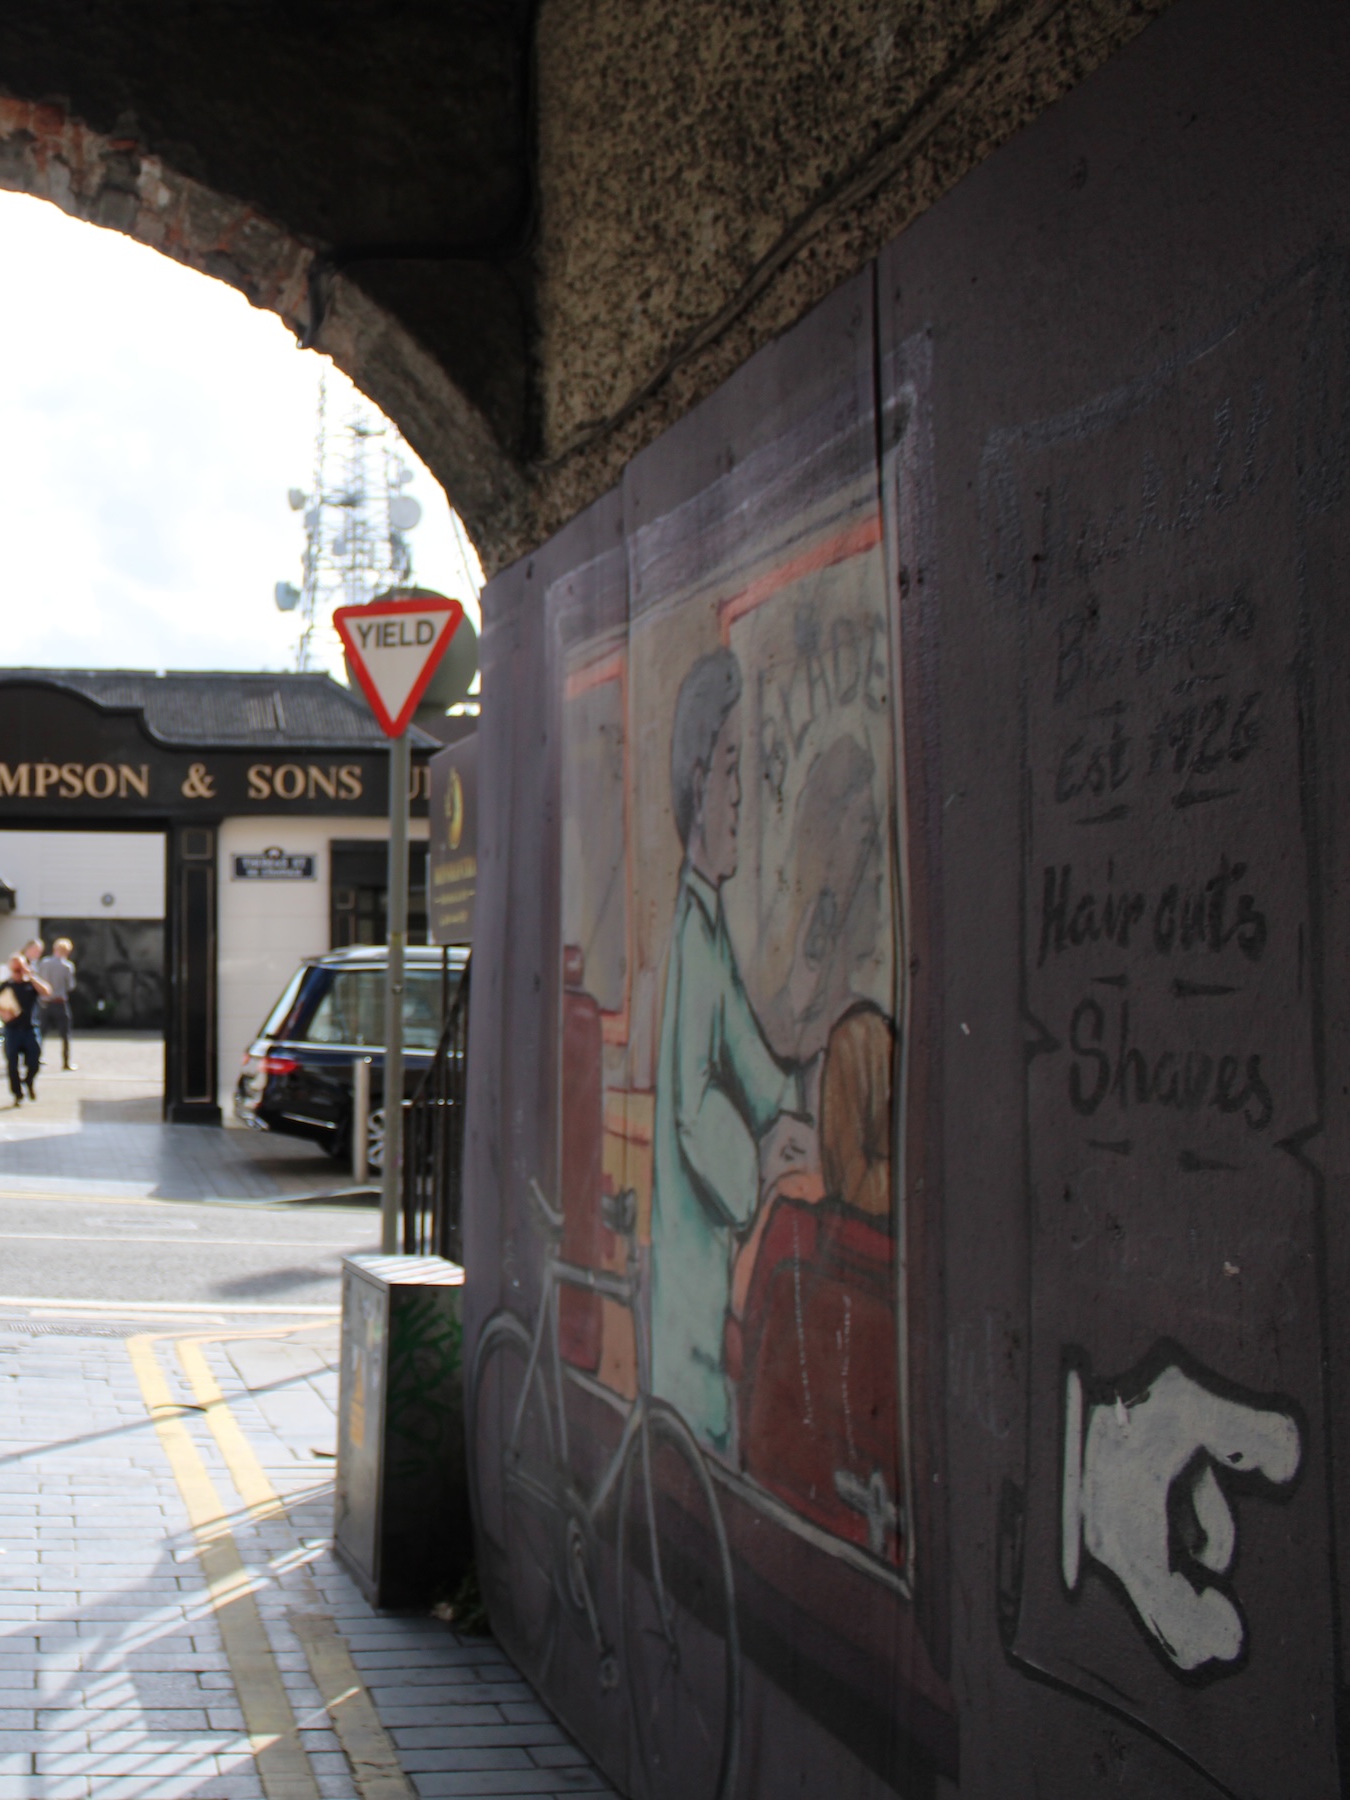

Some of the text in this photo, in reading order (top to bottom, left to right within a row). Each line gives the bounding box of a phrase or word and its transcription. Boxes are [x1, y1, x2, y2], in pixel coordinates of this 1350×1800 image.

[356, 619, 435, 649] YIELD
[181, 763, 216, 798] &
[247, 764, 363, 800] SONS
[1068, 997, 1274, 1131] Shaves
